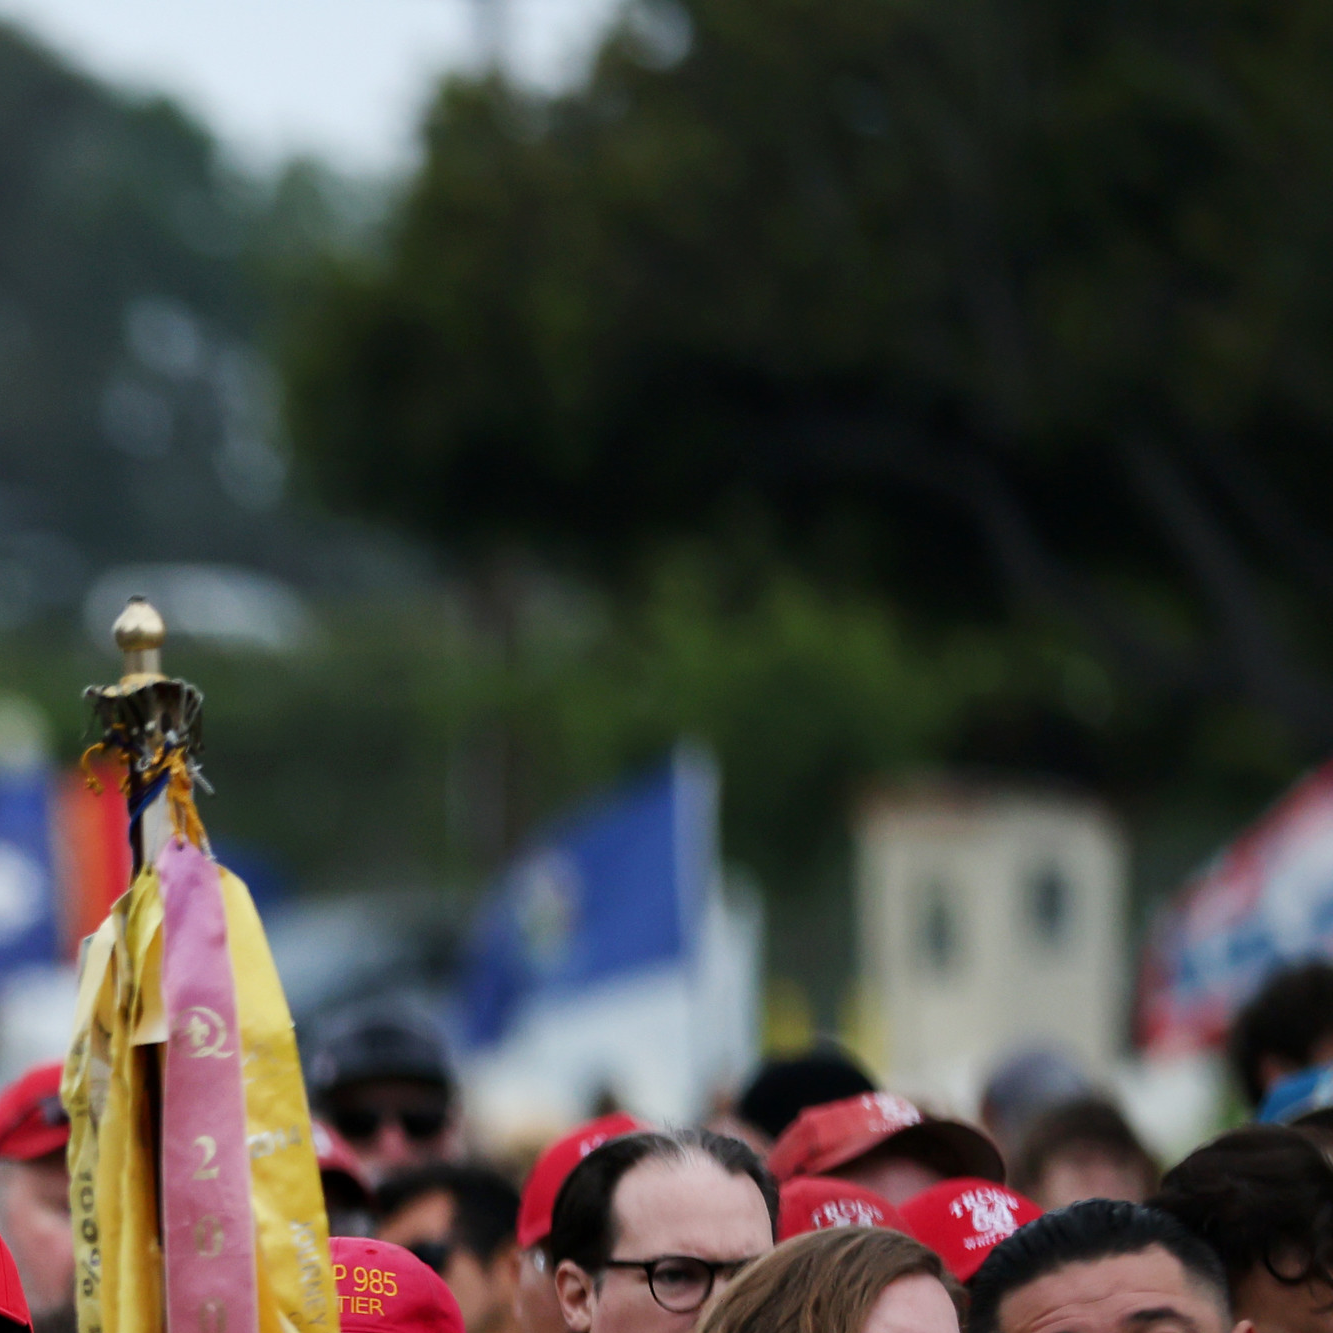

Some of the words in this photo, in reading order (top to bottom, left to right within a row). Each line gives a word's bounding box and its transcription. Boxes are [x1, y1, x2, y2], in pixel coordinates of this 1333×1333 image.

[289, 1218, 329, 1328] JOURNEY
[353, 1266, 398, 1297] 985
[336, 1295, 385, 1317] TIER
